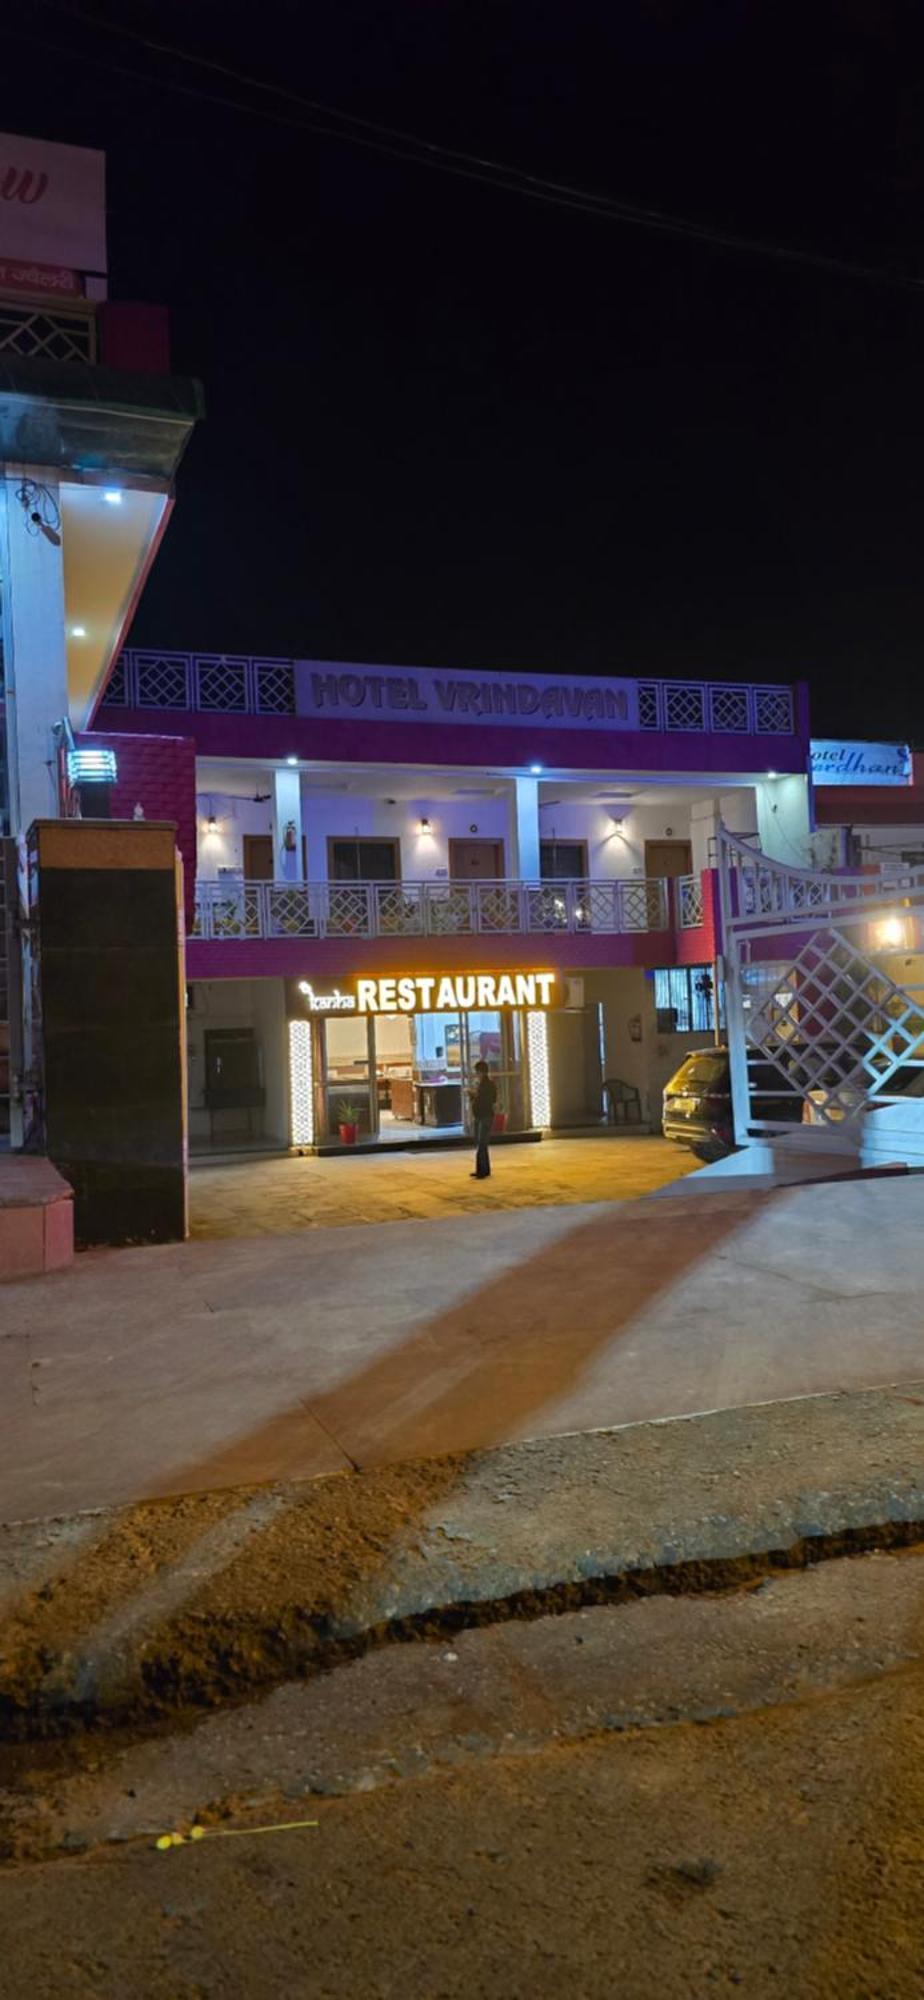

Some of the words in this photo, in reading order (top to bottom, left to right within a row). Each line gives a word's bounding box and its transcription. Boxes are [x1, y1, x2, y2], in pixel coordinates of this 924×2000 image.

[310, 672, 428, 710] HOTEL
[433, 678, 629, 721] VRINDAVAN
[357, 973, 555, 1012] RESTAURANT
